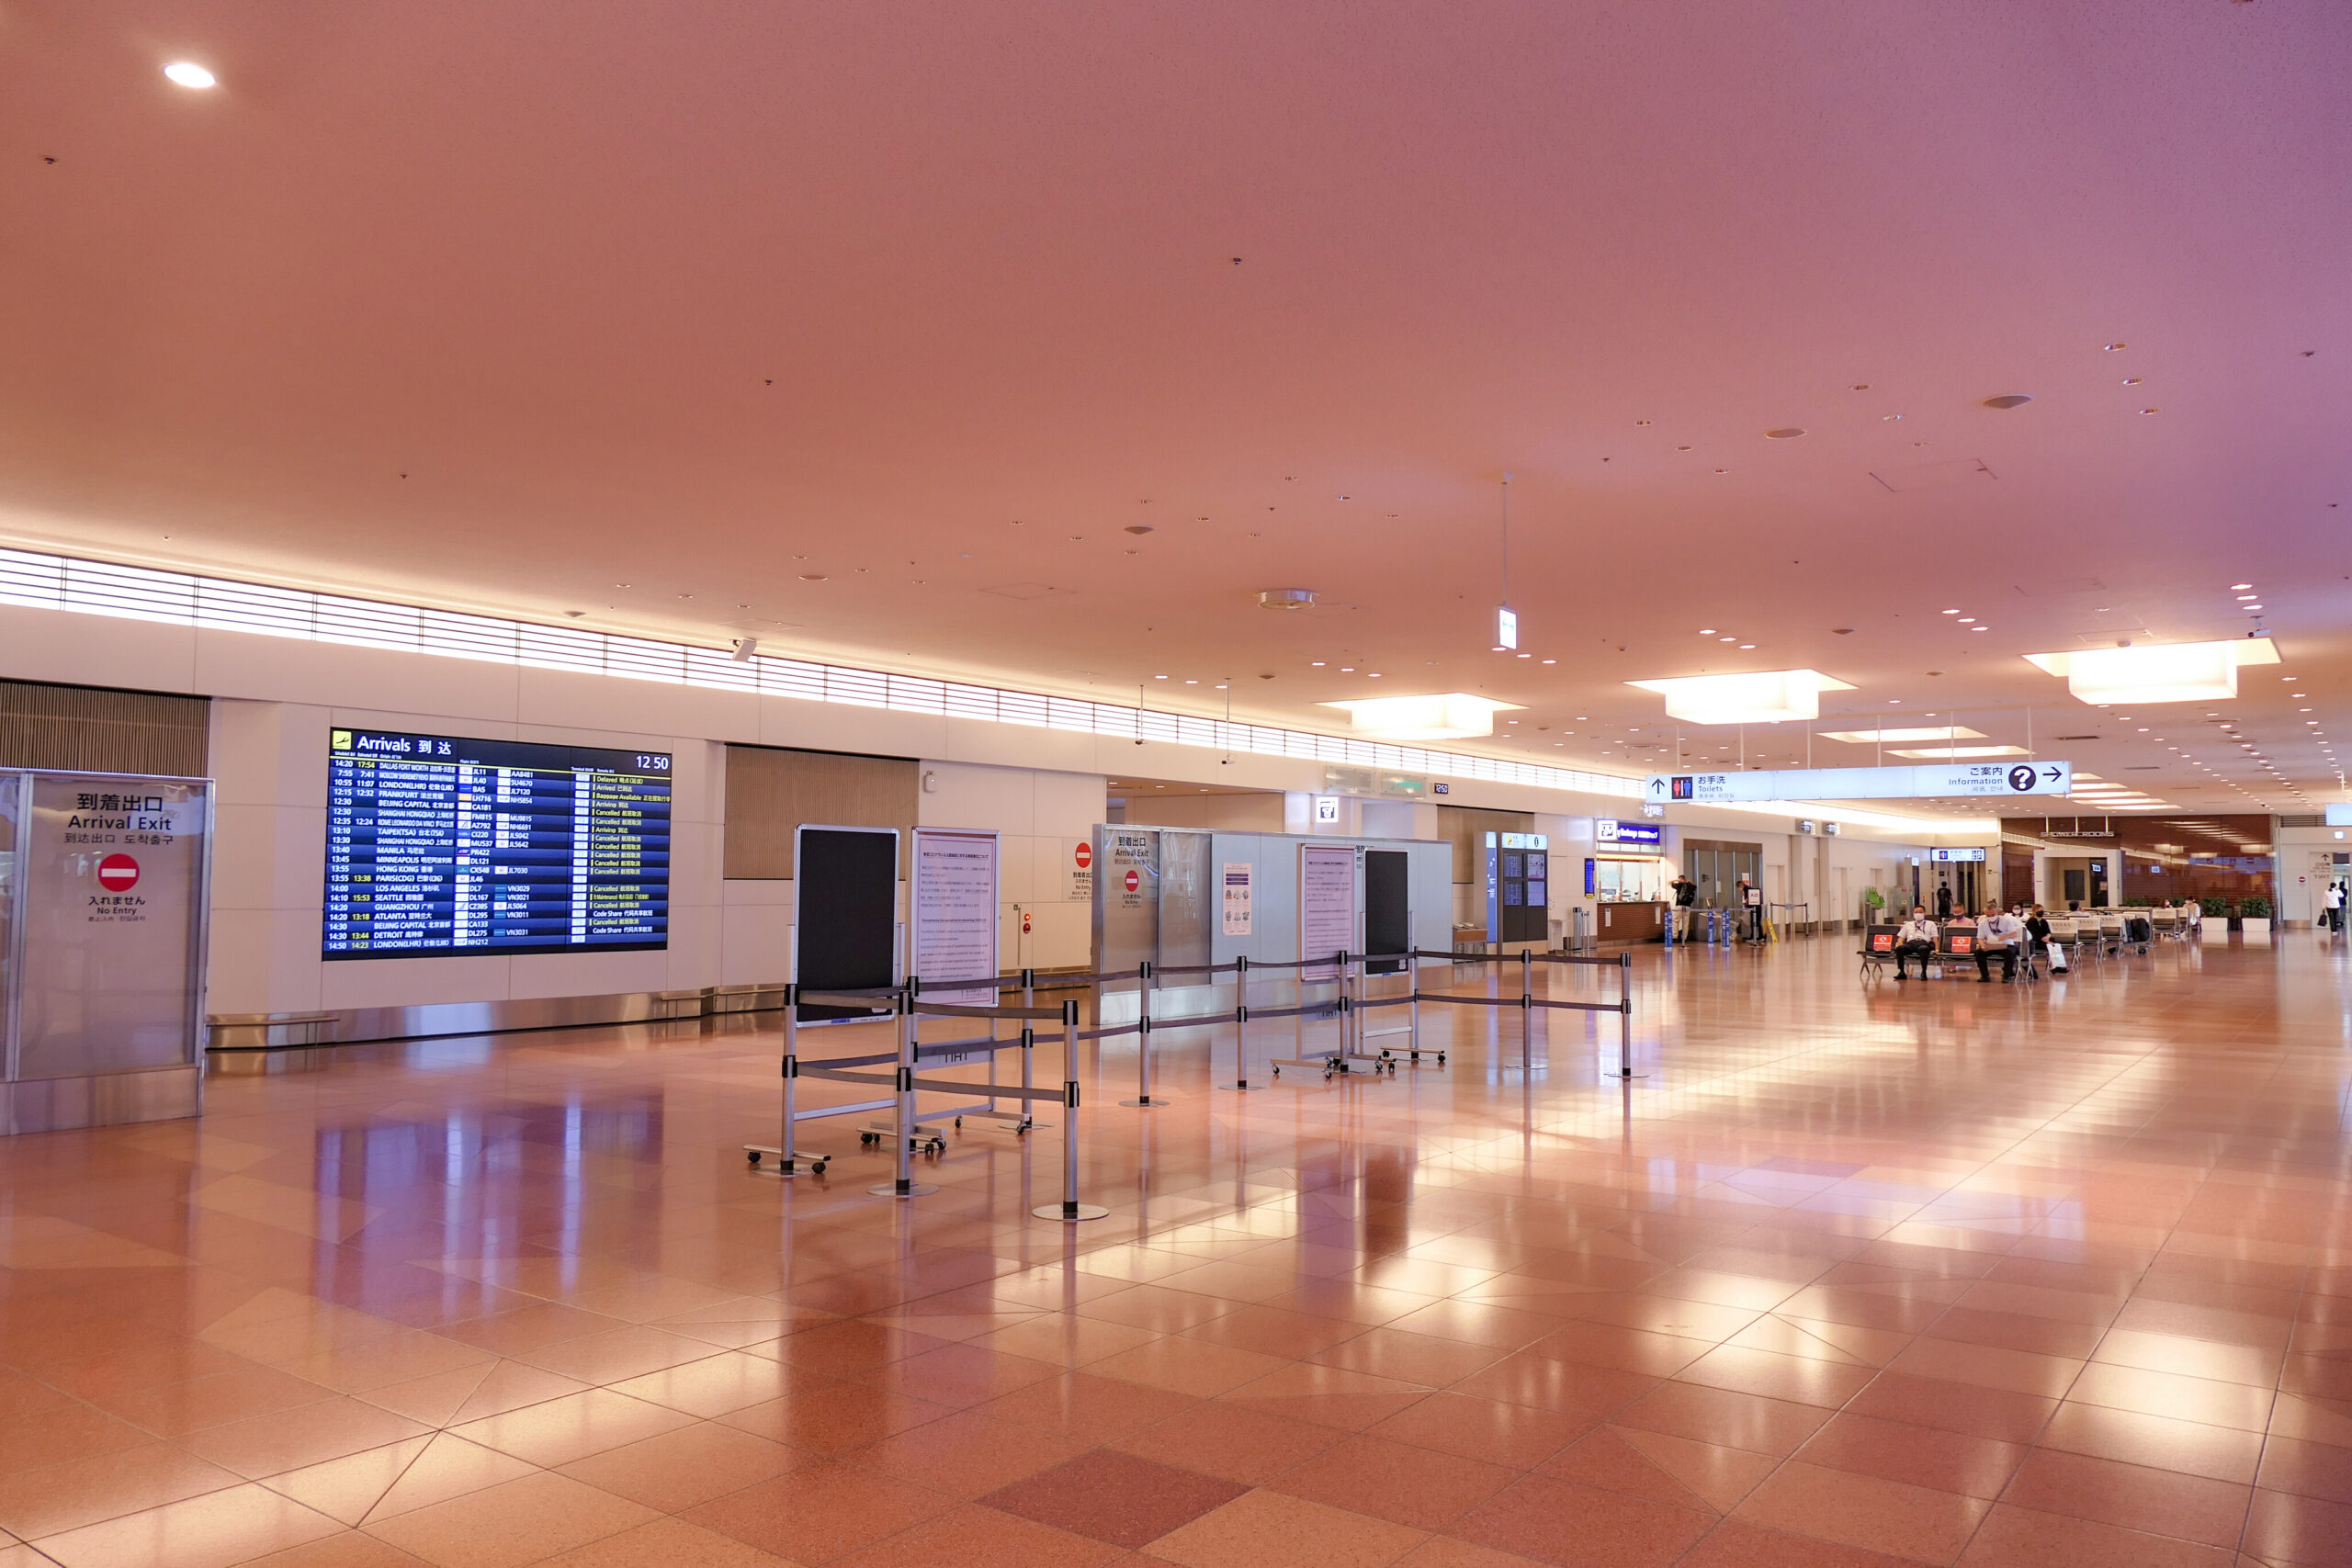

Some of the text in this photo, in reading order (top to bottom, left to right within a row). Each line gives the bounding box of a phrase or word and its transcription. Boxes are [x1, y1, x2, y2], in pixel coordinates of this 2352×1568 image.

[356, 736, 411, 751] Arrivals
[1970, 767, 2003, 775] ご案内
[1698, 776, 1725, 784] お手洗
[77, 794, 163, 812] 到着出口
[68, 816, 171, 830] Arrival Exit
[64, 833, 174, 845] 到达出口 도착출구
[1119, 837, 1146, 846] 到着出口
[88, 897, 145, 906] 入れません
